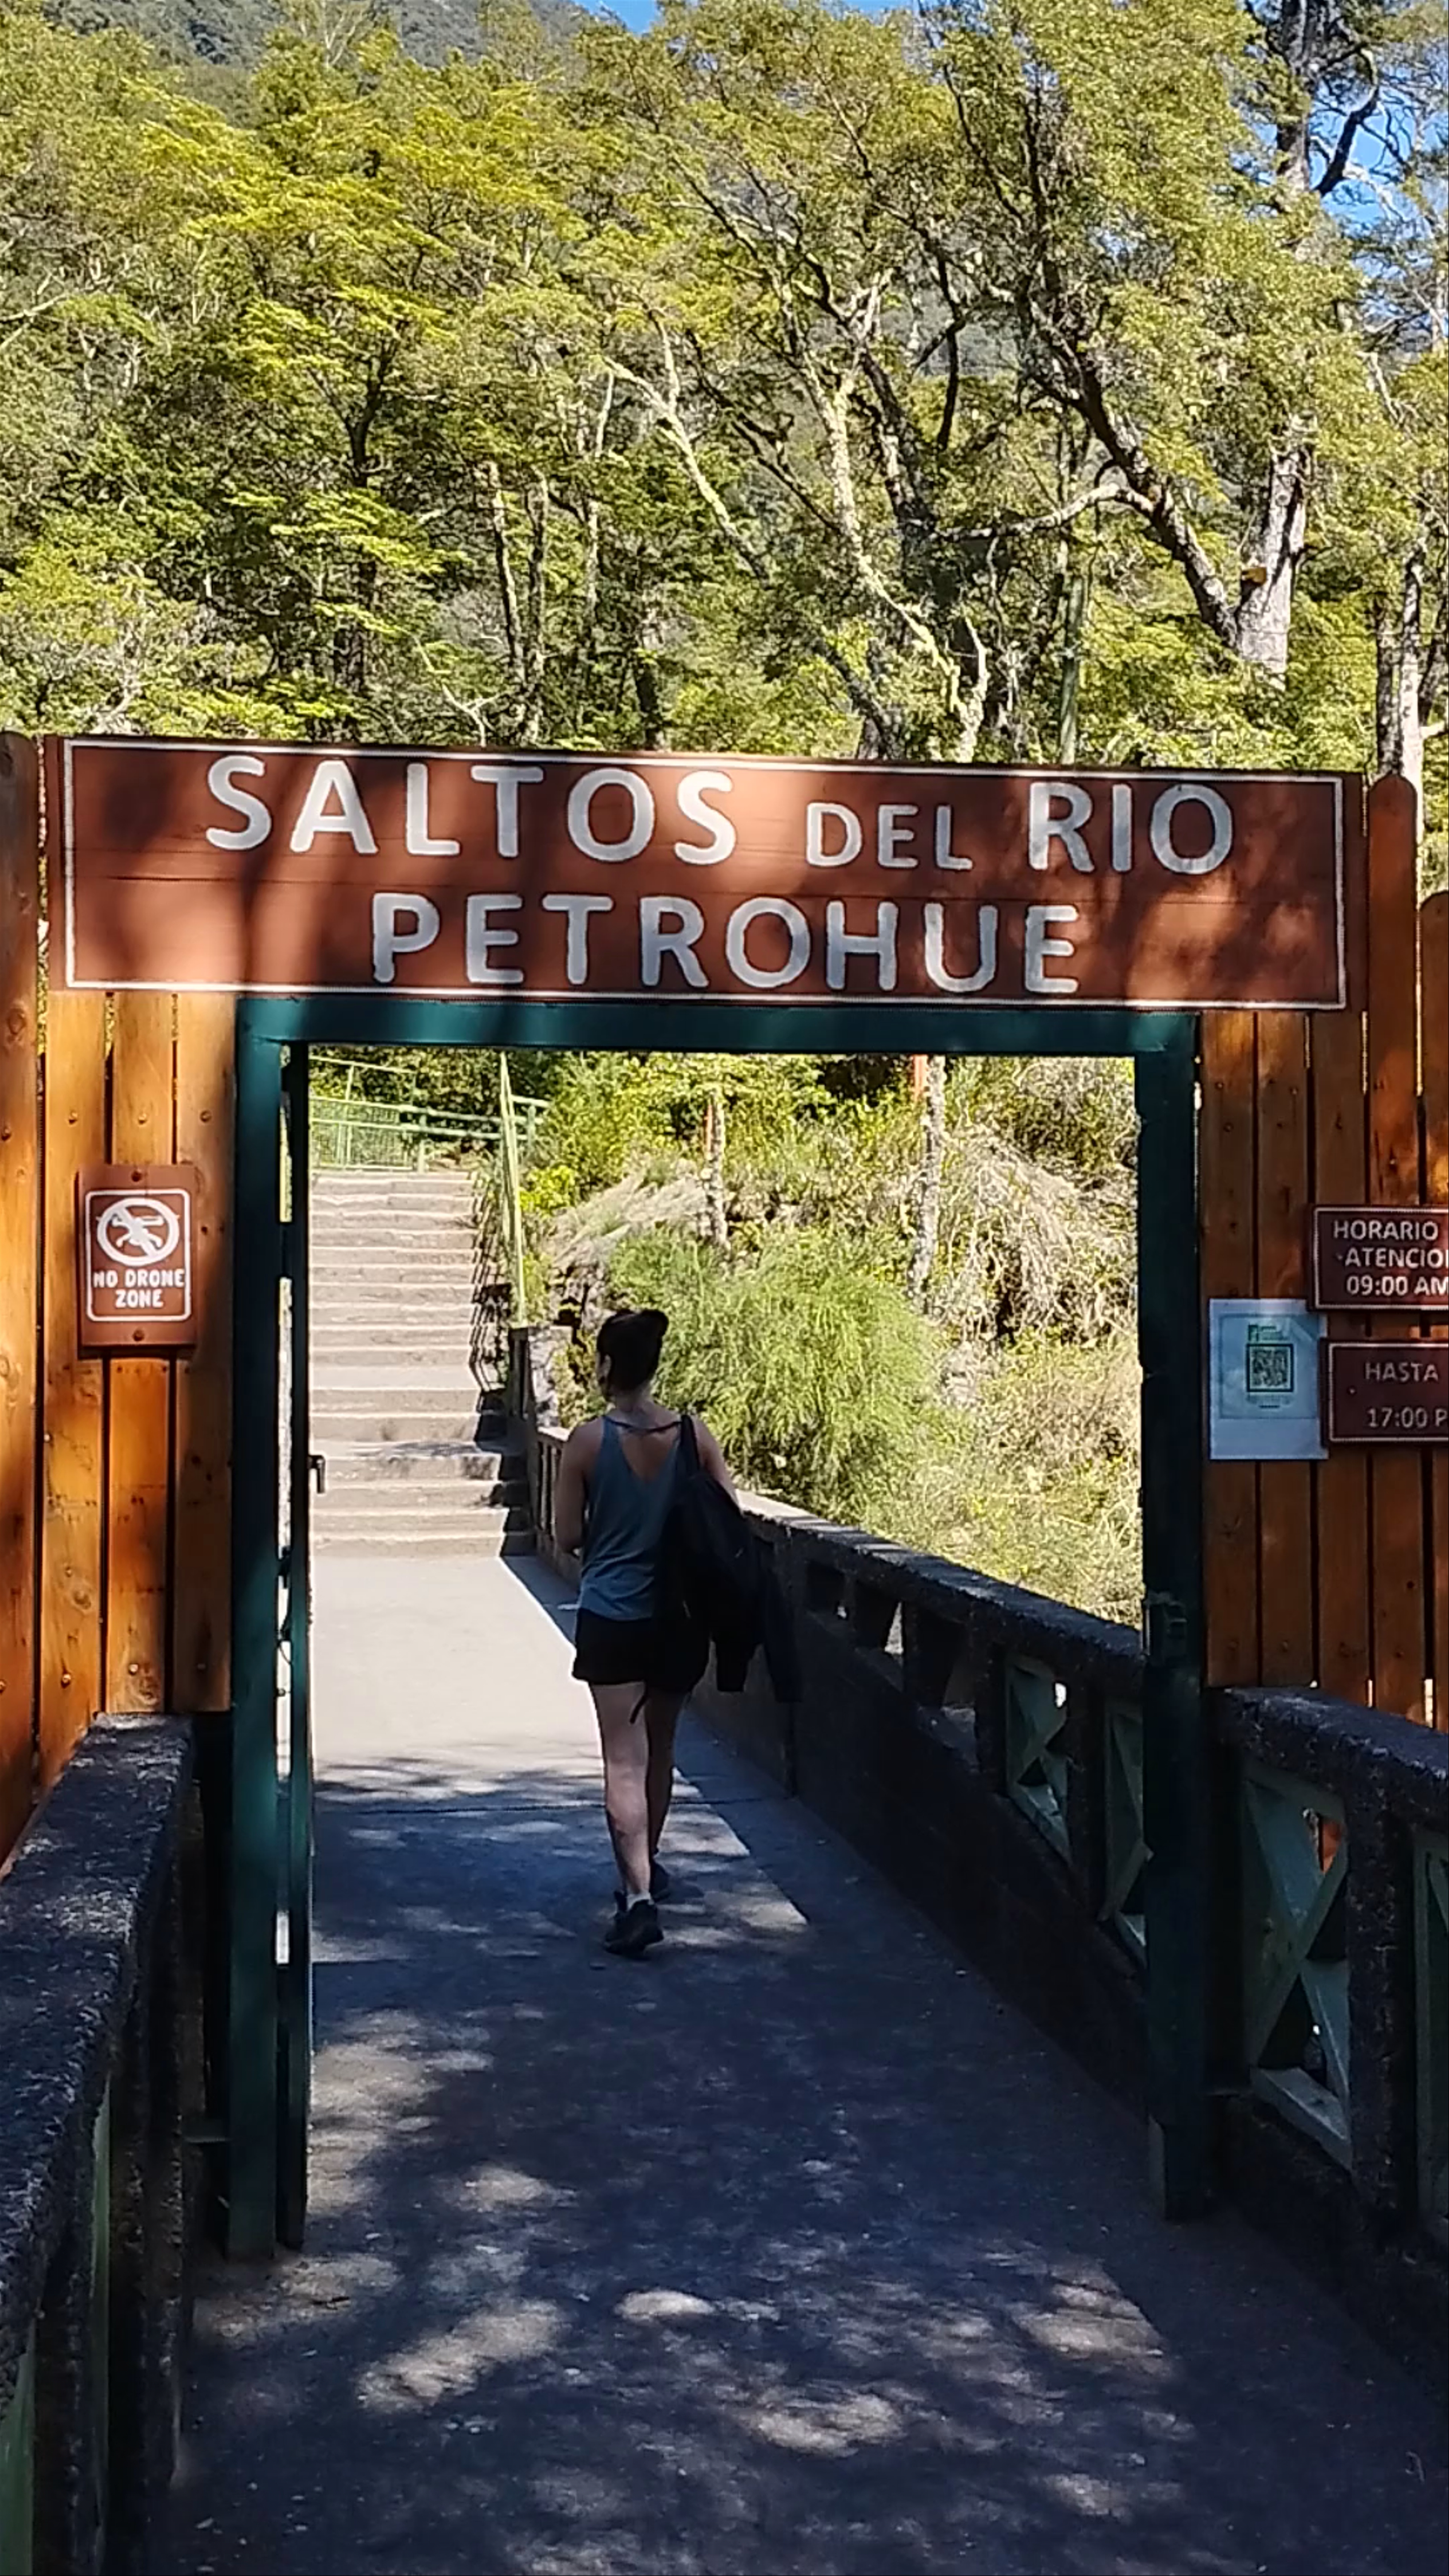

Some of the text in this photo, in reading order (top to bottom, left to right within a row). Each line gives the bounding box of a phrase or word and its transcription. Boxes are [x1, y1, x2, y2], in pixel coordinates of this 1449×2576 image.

[205, 755, 1234, 875] SALTOS DEL RIO
[372, 892, 1079, 994] PETROHUE
[1333, 1220, 1438, 1241] HORARIO
[1344, 1247, 1449, 1269] ATENCIO
[93, 1269, 185, 1288] NO DRONE
[1346, 1275, 1449, 1296] 09:00 AM
[115, 1289, 164, 1308] ZONE
[1365, 1362, 1439, 1382] HASTA
[1367, 1407, 1427, 1428] 17:00
